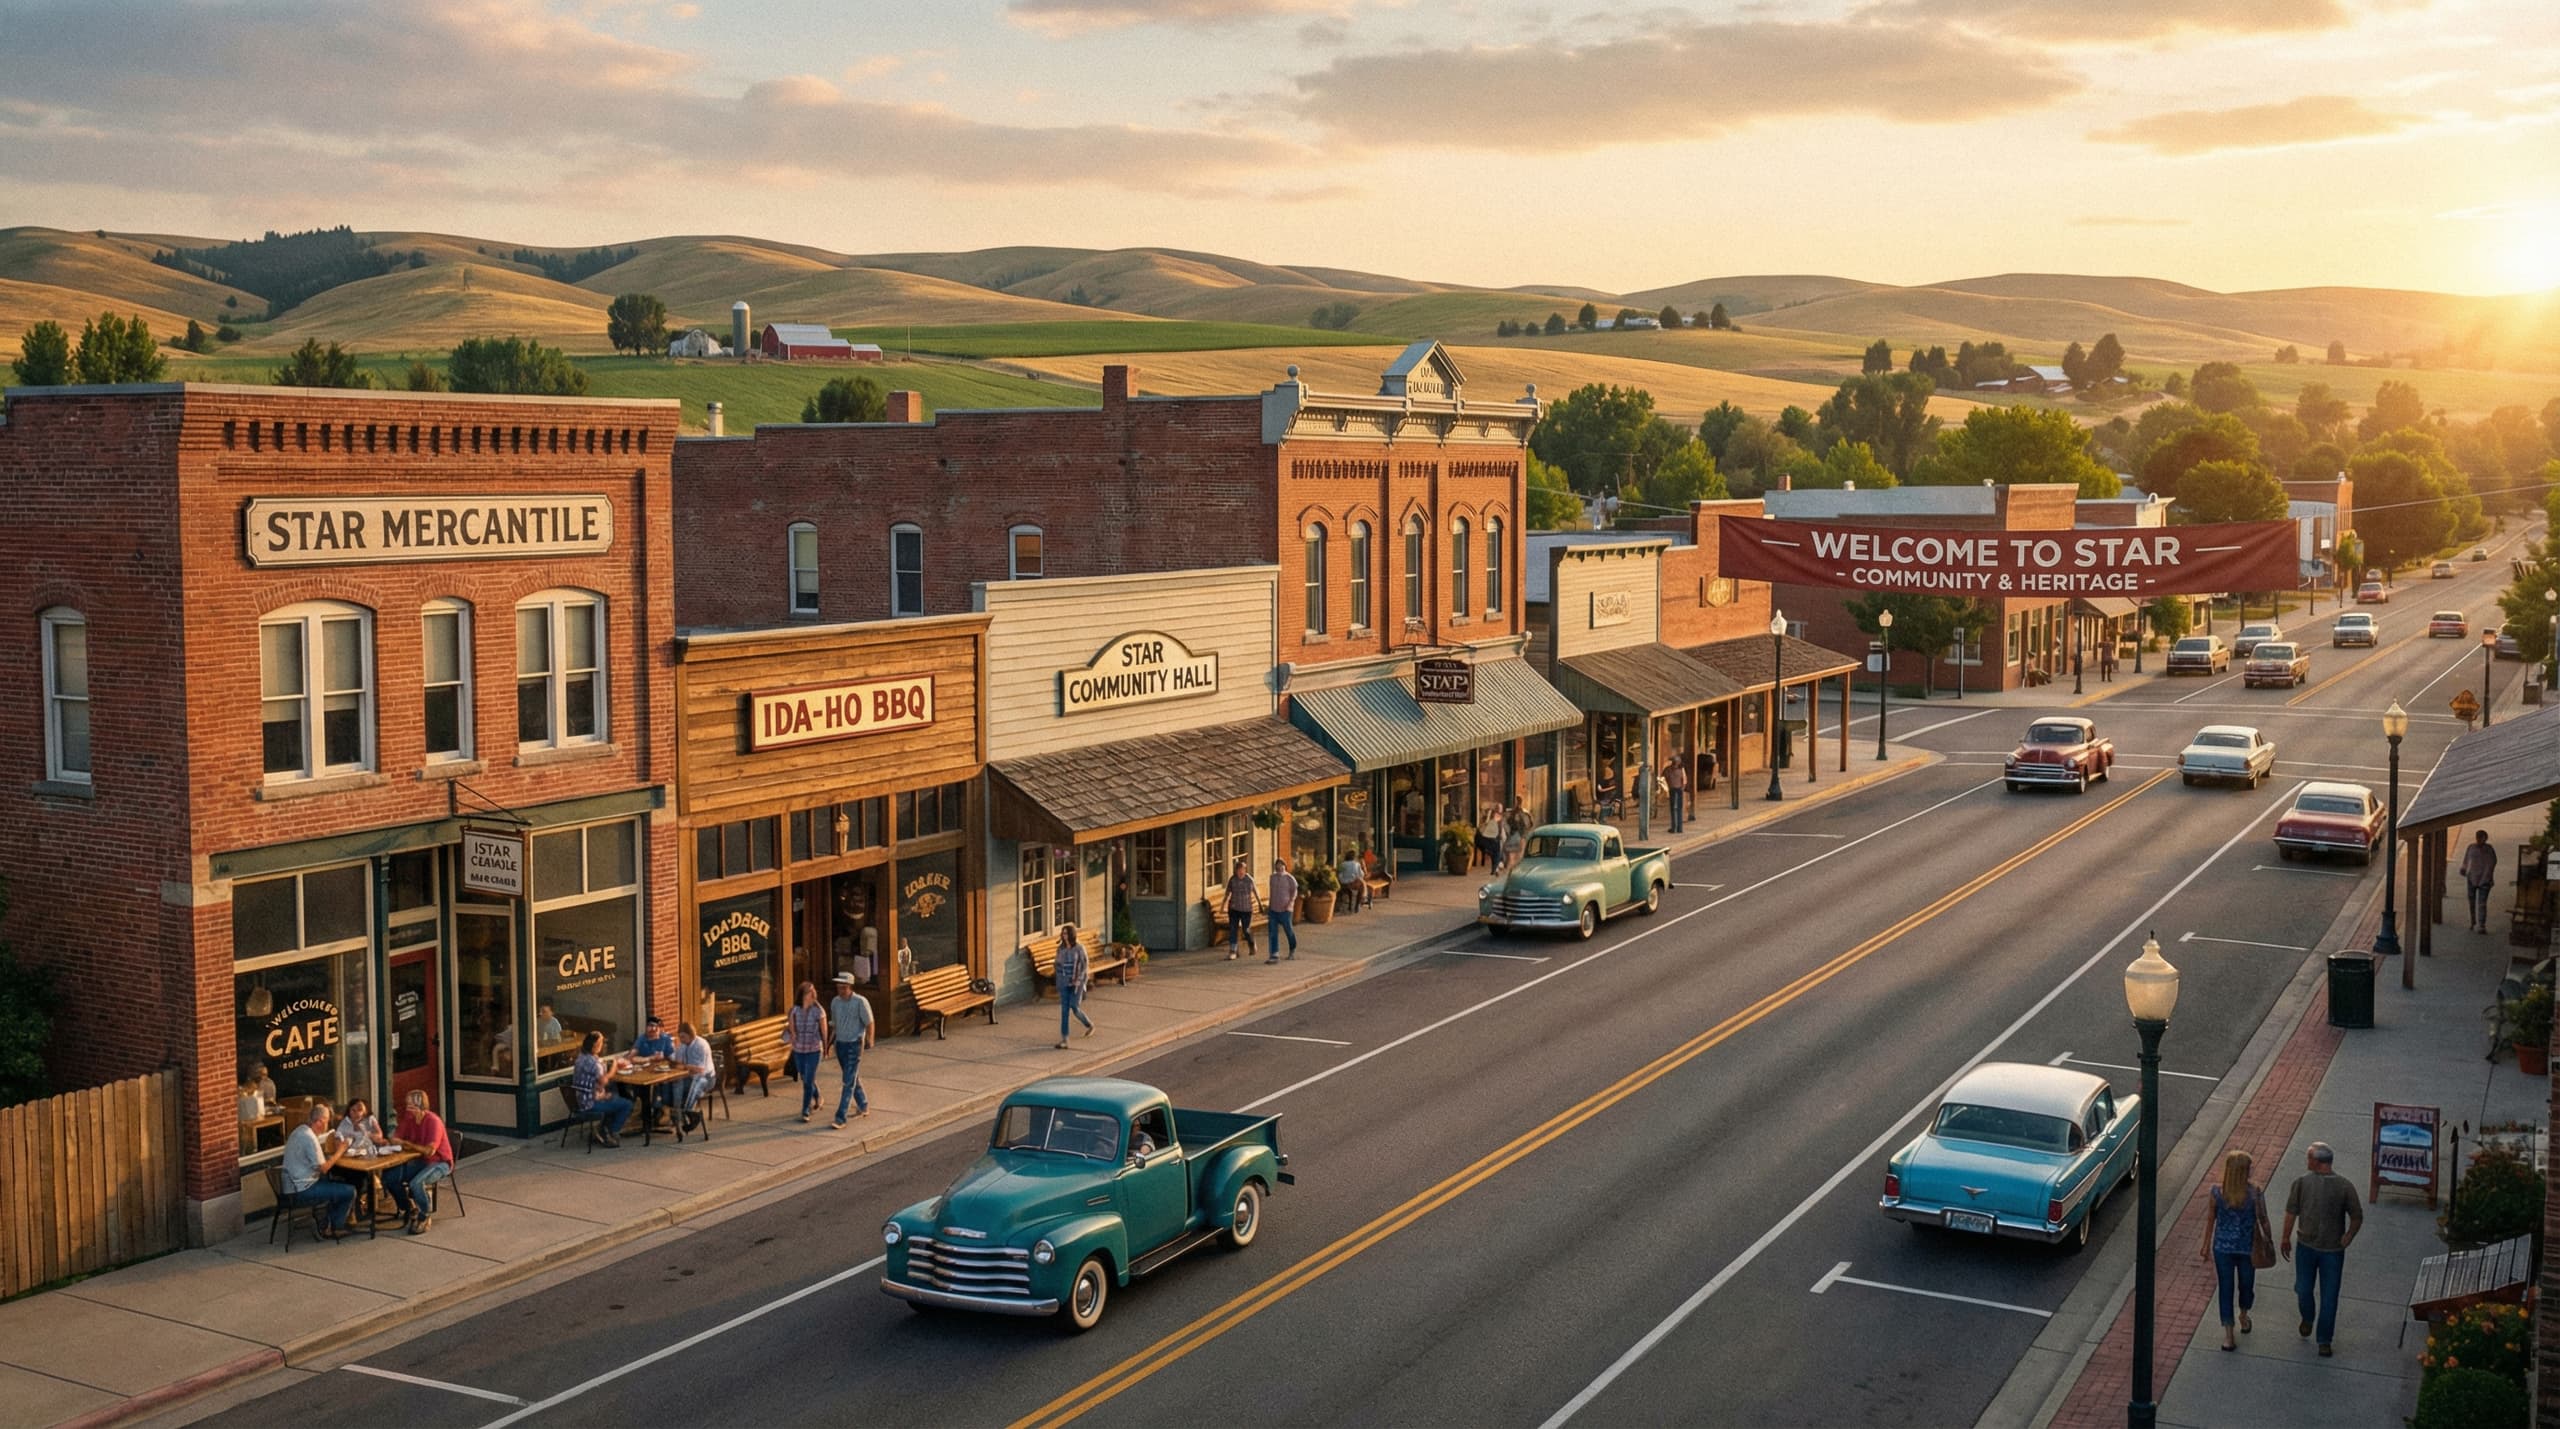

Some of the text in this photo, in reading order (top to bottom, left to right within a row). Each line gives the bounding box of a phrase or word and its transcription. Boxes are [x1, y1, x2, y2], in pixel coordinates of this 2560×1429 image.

[267, 506, 600, 552] STAR MERCANTILE
[1811, 531, 2181, 567] WELCOME TO STAR
[1852, 567, 2138, 592] COMMUNITY & HERITAGE
[1121, 641, 1164, 667] STAR
[1069, 664, 1213, 704] COMMUNITY HALL
[763, 685, 926, 738] IDA-HO BBQ
[558, 945, 616, 977] CAFE
[722, 932, 751, 955] BBQ
[265, 1016, 339, 1057] CAFE
